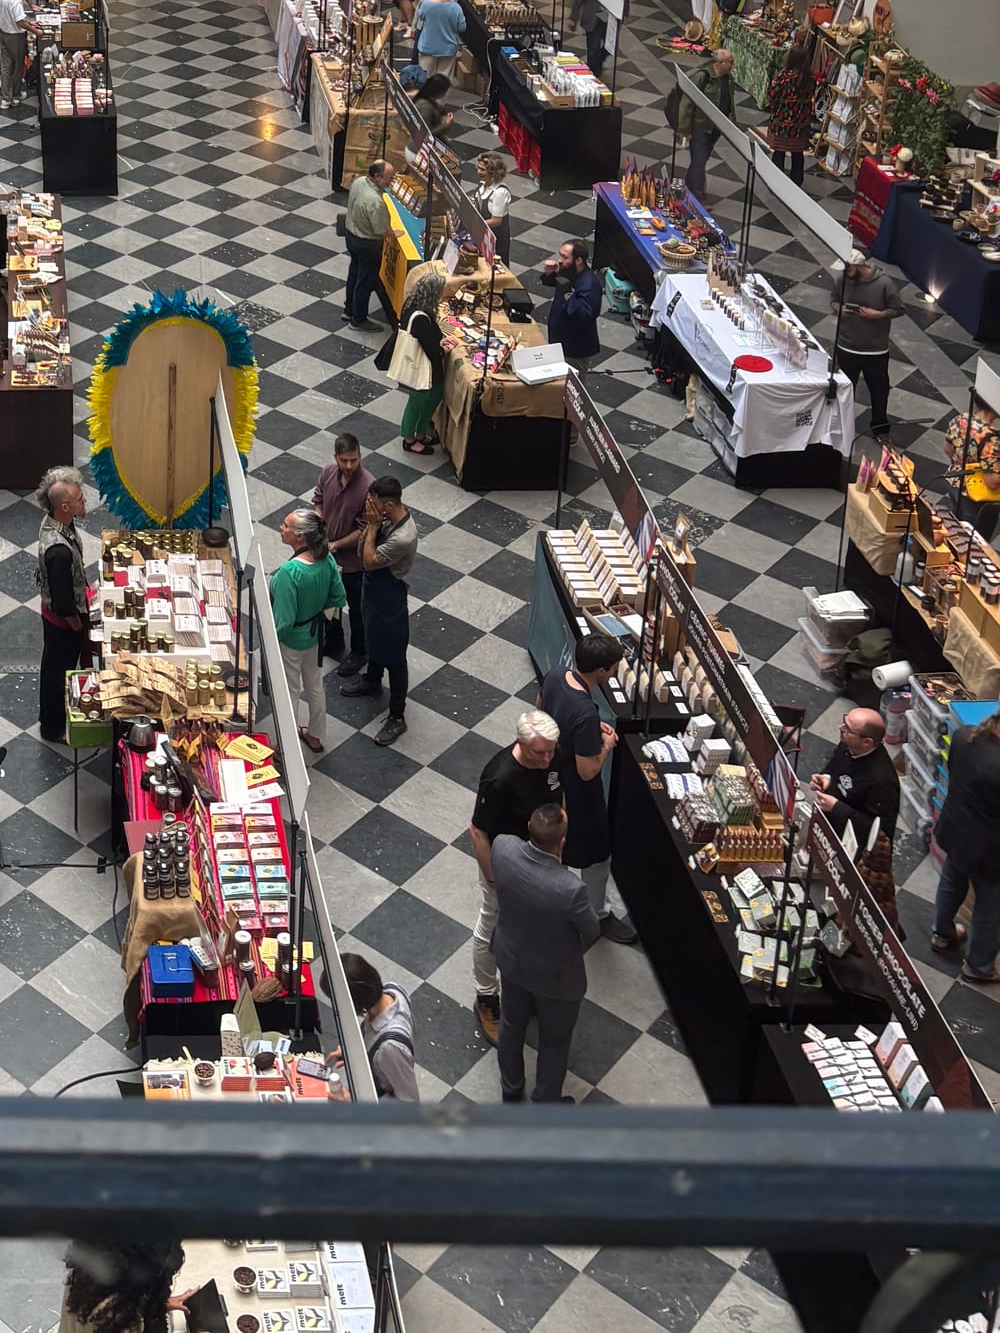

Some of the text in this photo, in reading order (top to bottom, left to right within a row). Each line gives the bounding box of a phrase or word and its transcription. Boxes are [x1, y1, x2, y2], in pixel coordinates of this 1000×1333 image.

[812, 822, 834, 864] SHOW
[827, 854, 850, 899] COLAT
[855, 914, 879, 959] SUFFOLK
[882, 943, 926, 1018] CHOCOLATE
[337, 1284, 347, 1305] melt
[298, 1308, 306, 1328] melt
